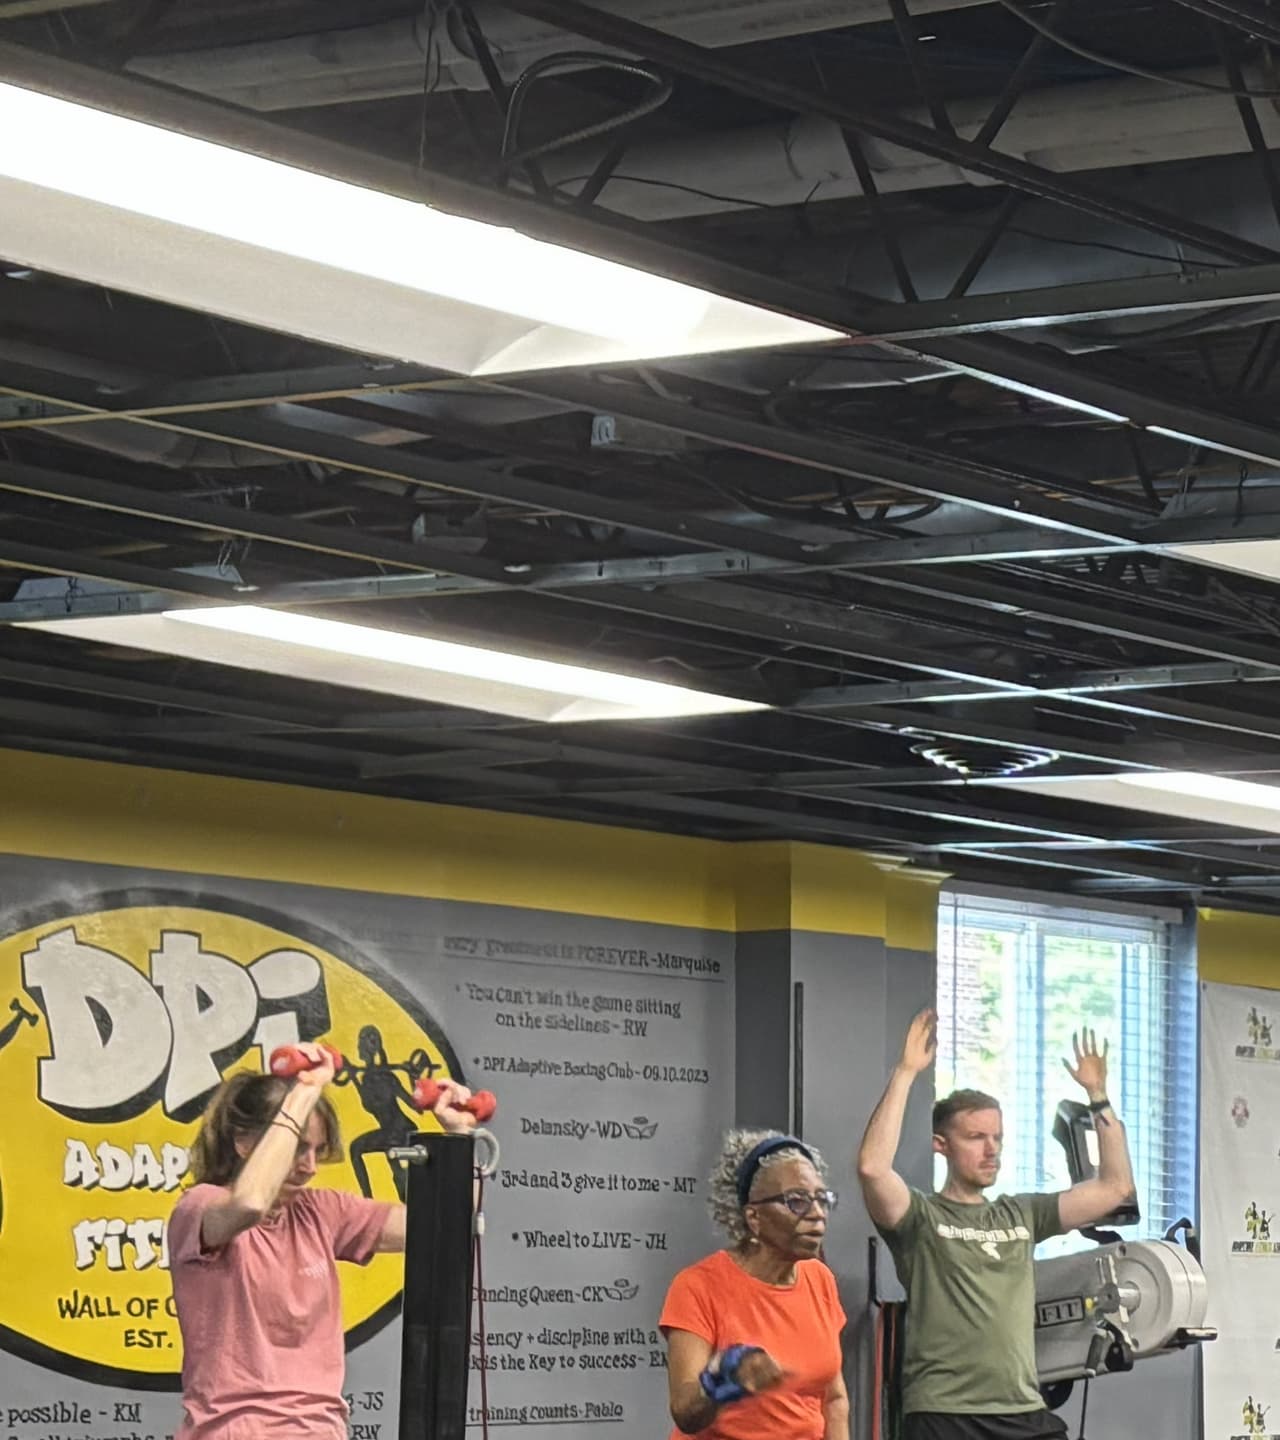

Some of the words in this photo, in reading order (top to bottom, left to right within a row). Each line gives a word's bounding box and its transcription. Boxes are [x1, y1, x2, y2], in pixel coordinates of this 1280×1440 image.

[566, 991, 589, 1009] the
[634, 998, 682, 1018] sitting
[496, 1013, 516, 1028] on
[518, 1011, 542, 1029] the
[623, 1019, 648, 1037] RW
[507, 1058, 562, 1078] Adaptive
[564, 1061, 606, 1081] Boxing
[64, 1139, 191, 1192] ADAP
[501, 1169, 528, 1189] 3rd
[529, 1171, 559, 1190] and
[561, 1171, 573, 1190] 3
[573, 1173, 606, 1195] give
[673, 1176, 698, 1194] MT
[522, 1230, 572, 1249] Wheel
[575, 1231, 590, 1248] to
[591, 1231, 632, 1249] LIVE
[645, 1233, 668, 1250] JH
[58, 1290, 120, 1319] WALL
[126, 1297, 159, 1319] OF
[1041, 1302, 1079, 1323] FIT
[124, 1329, 174, 1349] EST.
[537, 1328, 610, 1349] discipline
[613, 1327, 646, 1346] with
[500, 1354, 526, 1371] the
[528, 1352, 557, 1372] Key
[559, 1354, 575, 1369] to
[578, 1353, 637, 1371] success
[7, 1400, 92, 1428] possible
[112, 1402, 142, 1423] KM
